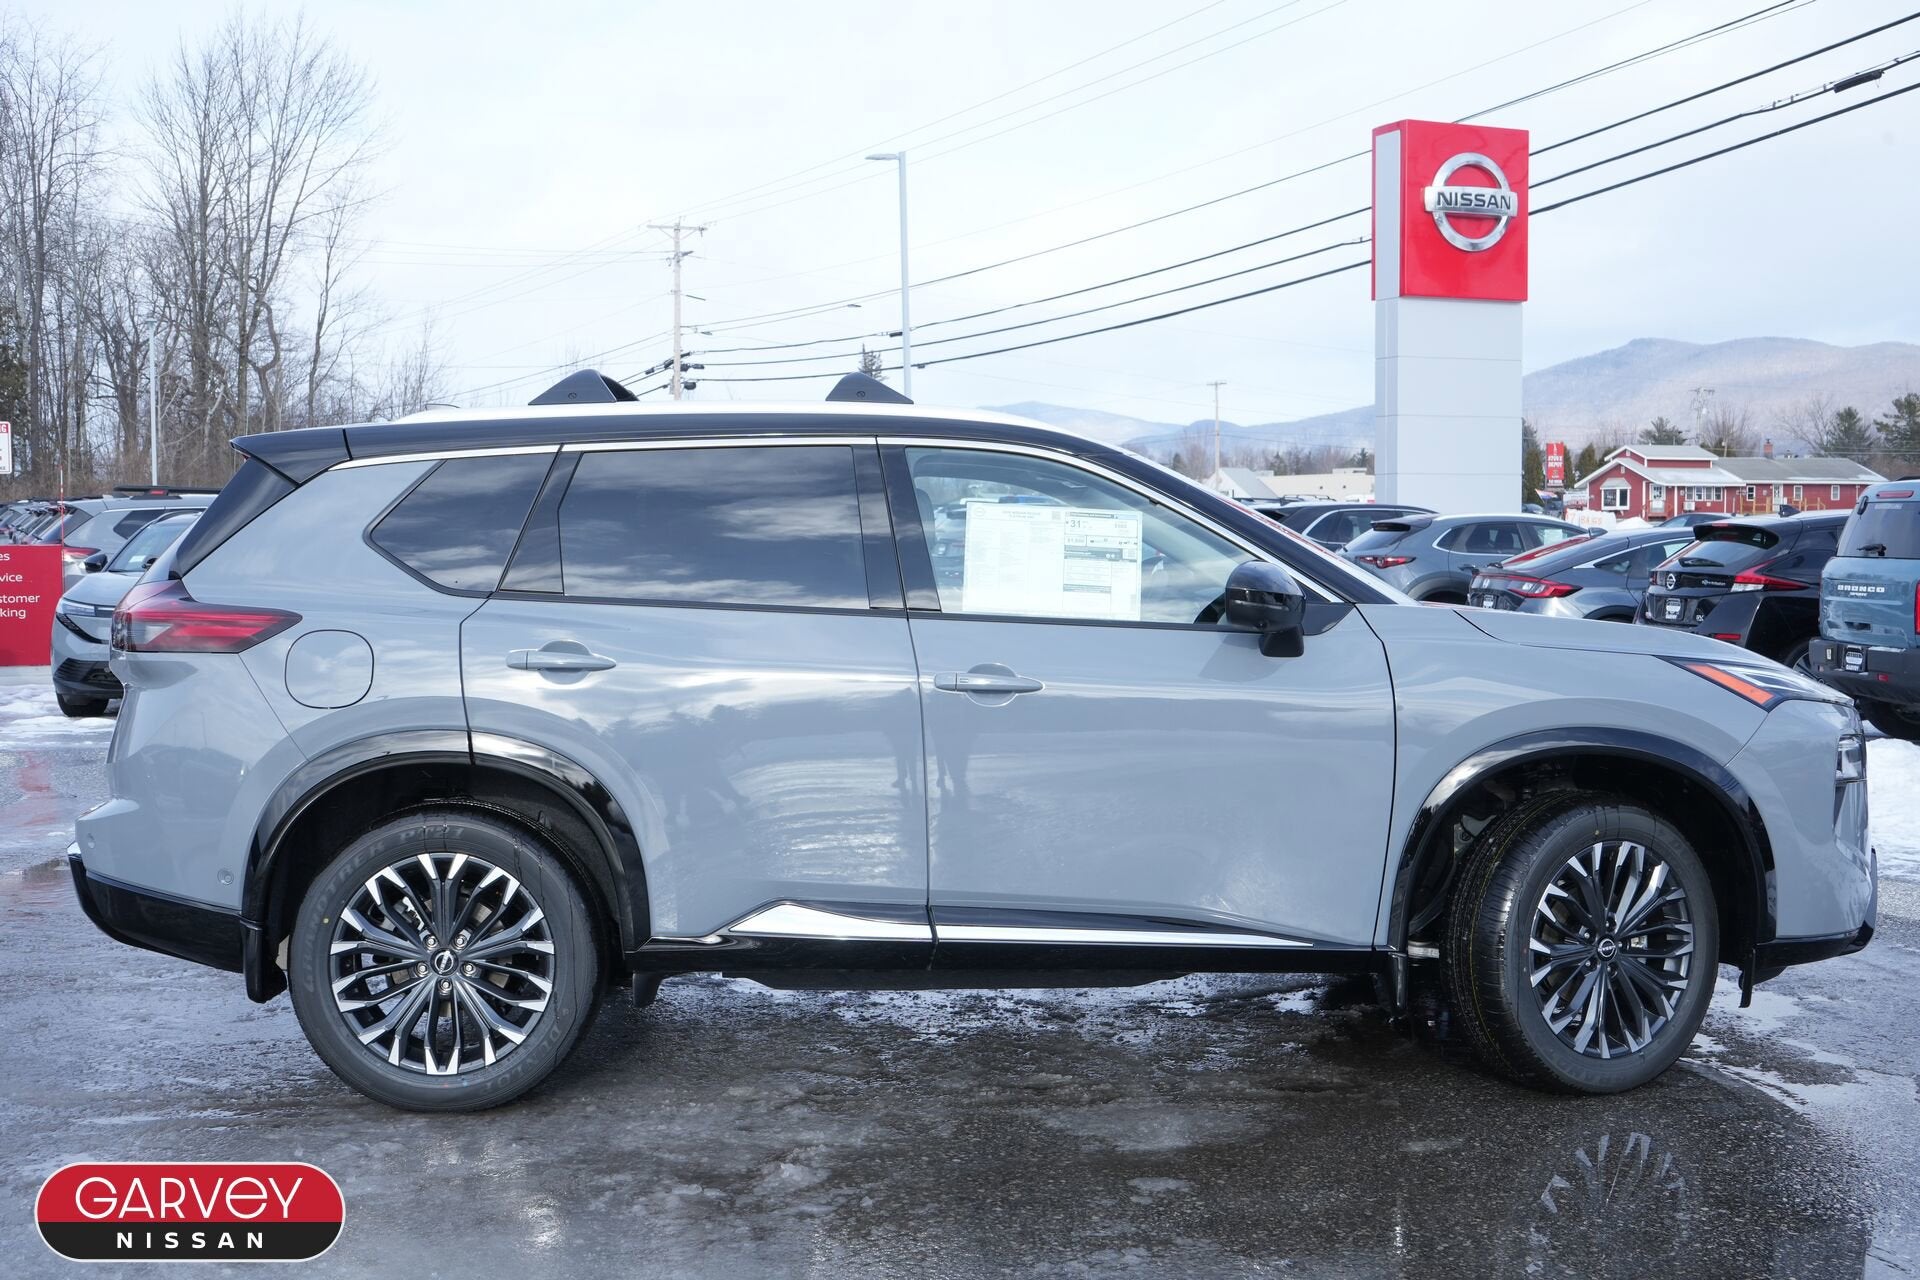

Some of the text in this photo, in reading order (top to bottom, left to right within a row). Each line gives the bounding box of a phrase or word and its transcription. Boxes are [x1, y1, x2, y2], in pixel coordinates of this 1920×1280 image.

[1437, 191, 1511, 210] NISSAN
[1837, 584, 1885, 593] BRONCO
[0, 608, 26, 619] king
